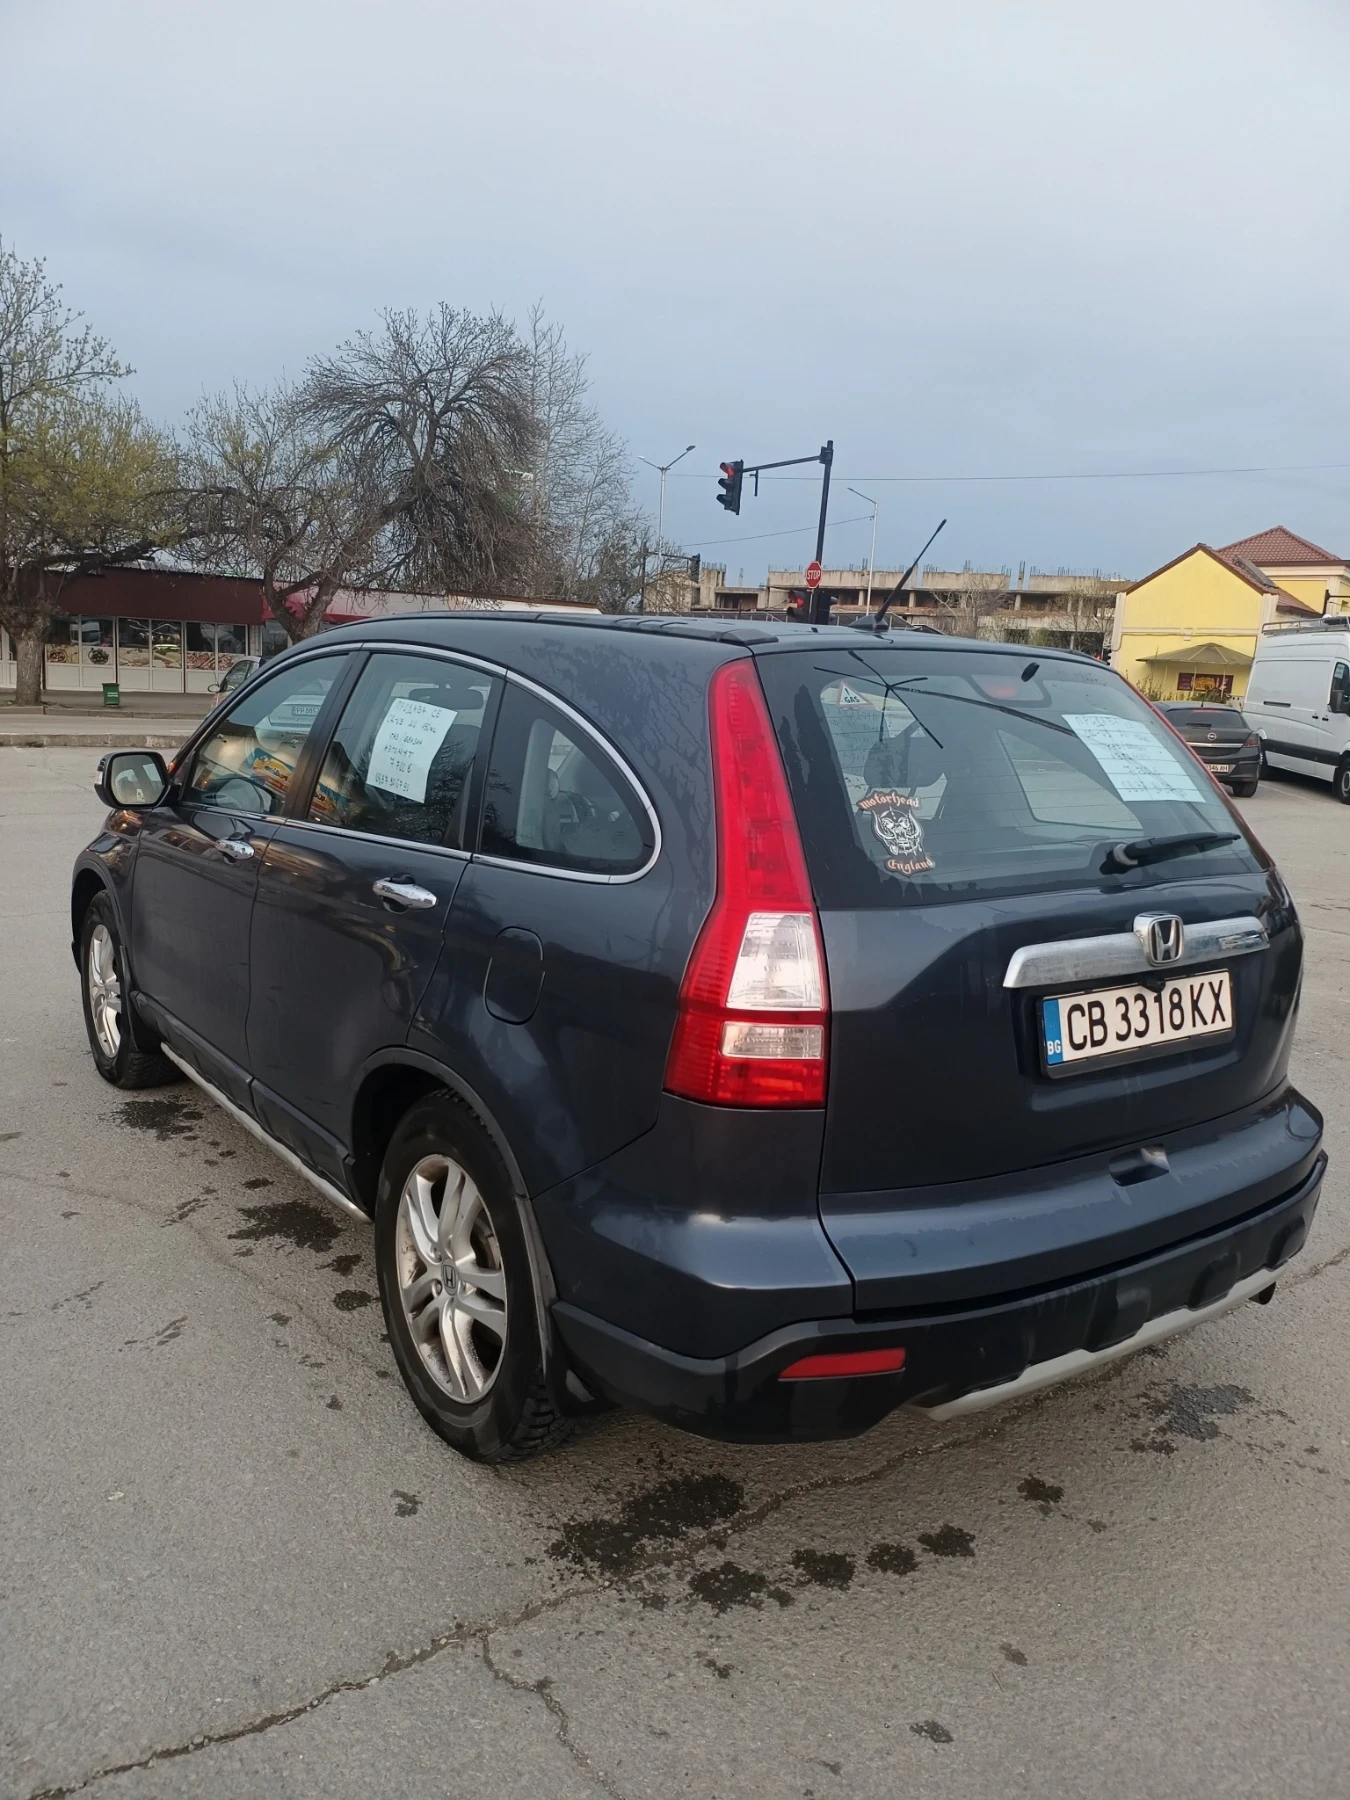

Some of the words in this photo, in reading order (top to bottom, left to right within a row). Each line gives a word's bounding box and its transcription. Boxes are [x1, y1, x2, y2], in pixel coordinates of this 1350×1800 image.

[807, 569, 820, 580] STOP
[887, 856, 933, 874] England
[1047, 1040, 1062, 1056] BG
